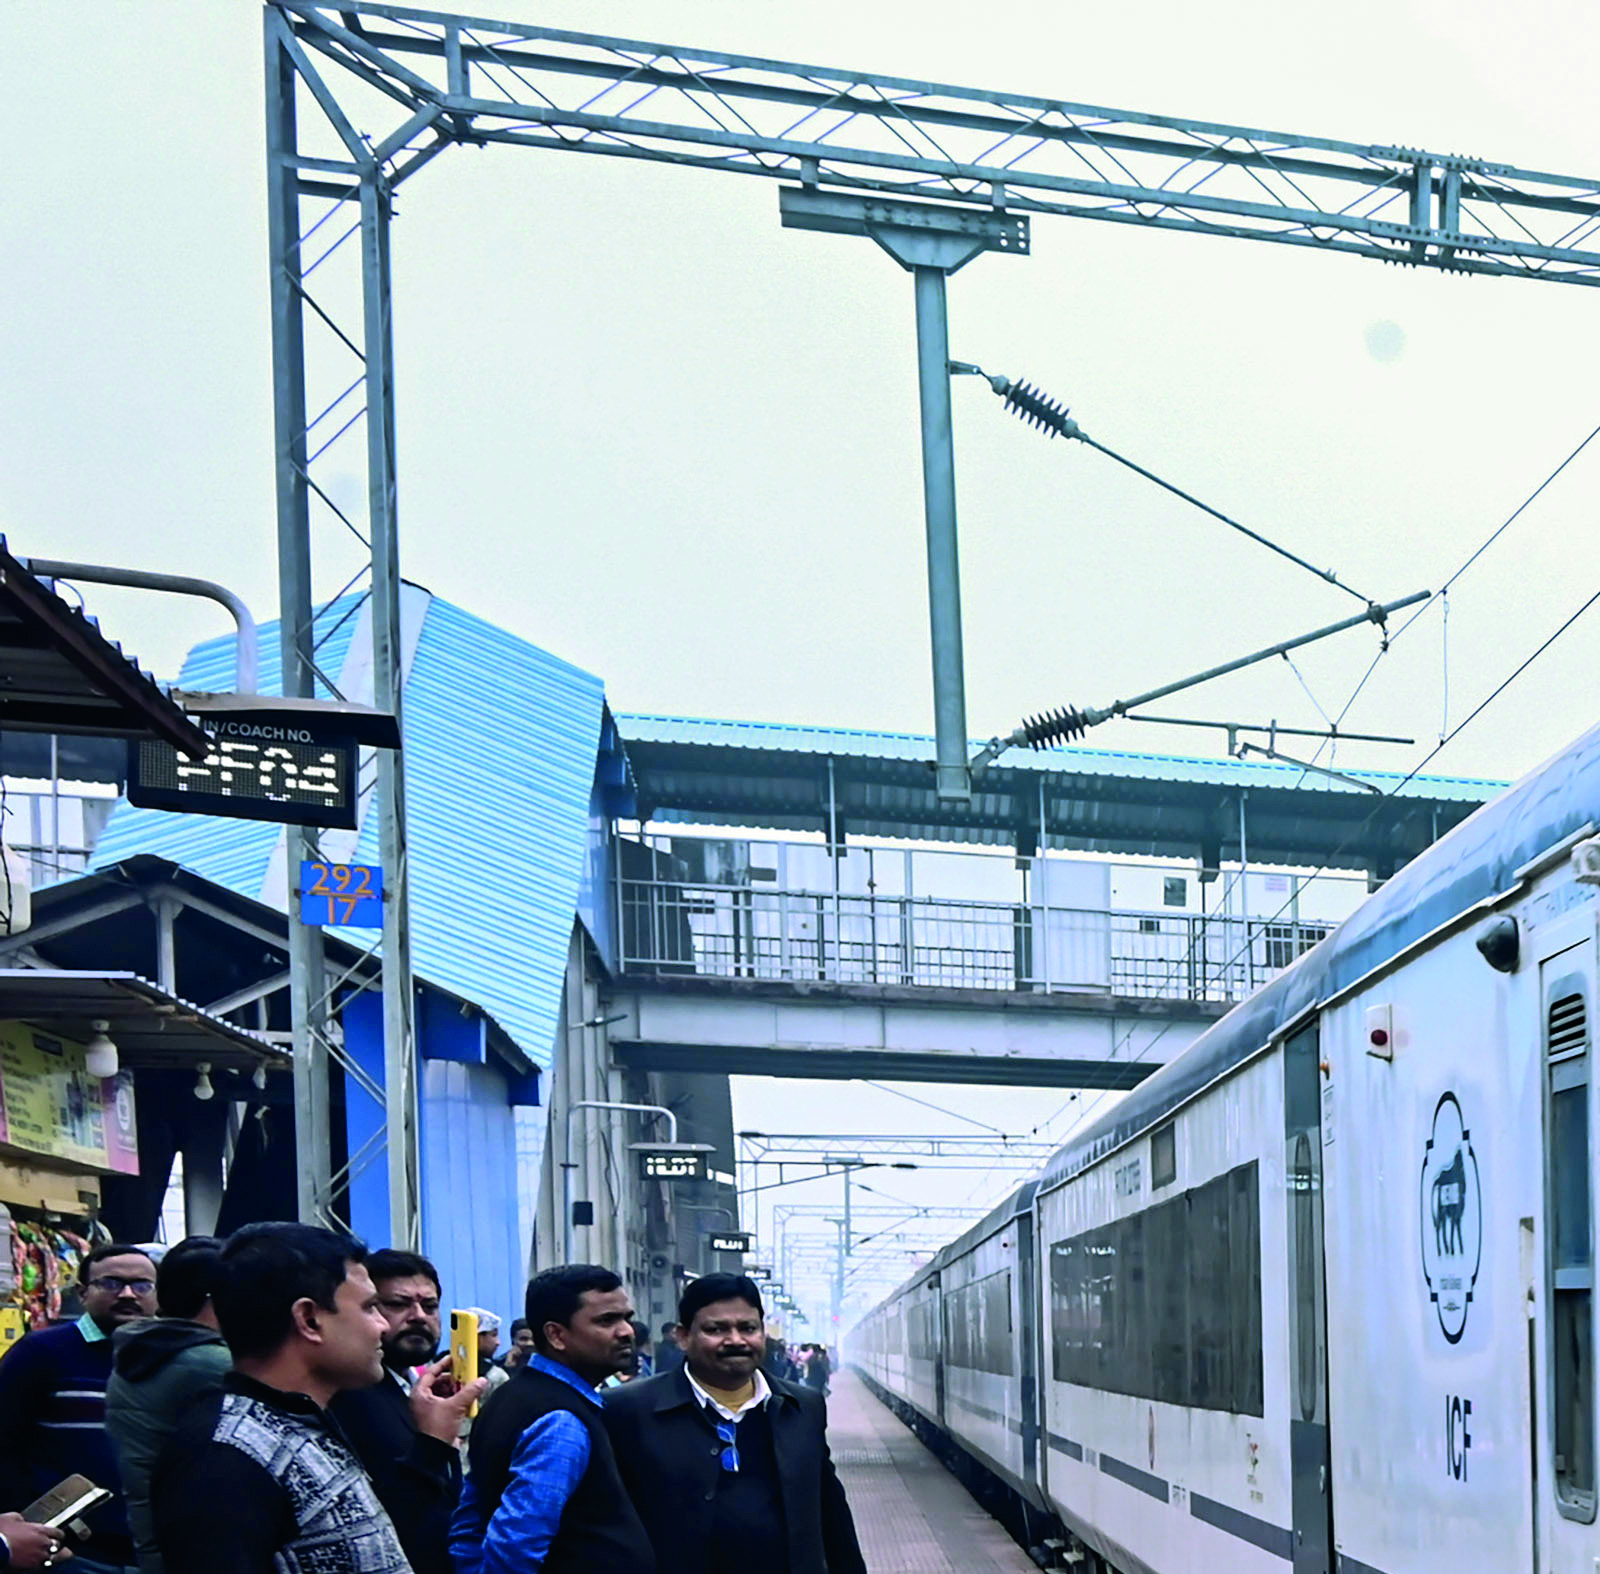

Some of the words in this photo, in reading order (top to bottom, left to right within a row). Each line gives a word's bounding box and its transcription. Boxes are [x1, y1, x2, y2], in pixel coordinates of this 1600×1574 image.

[203, 719, 285, 740] IN/COACH
[287, 729, 315, 744] NO.
[311, 864, 373, 894] 292
[328, 896, 358, 924] 17
[1446, 1394, 1472, 1482] ICF
